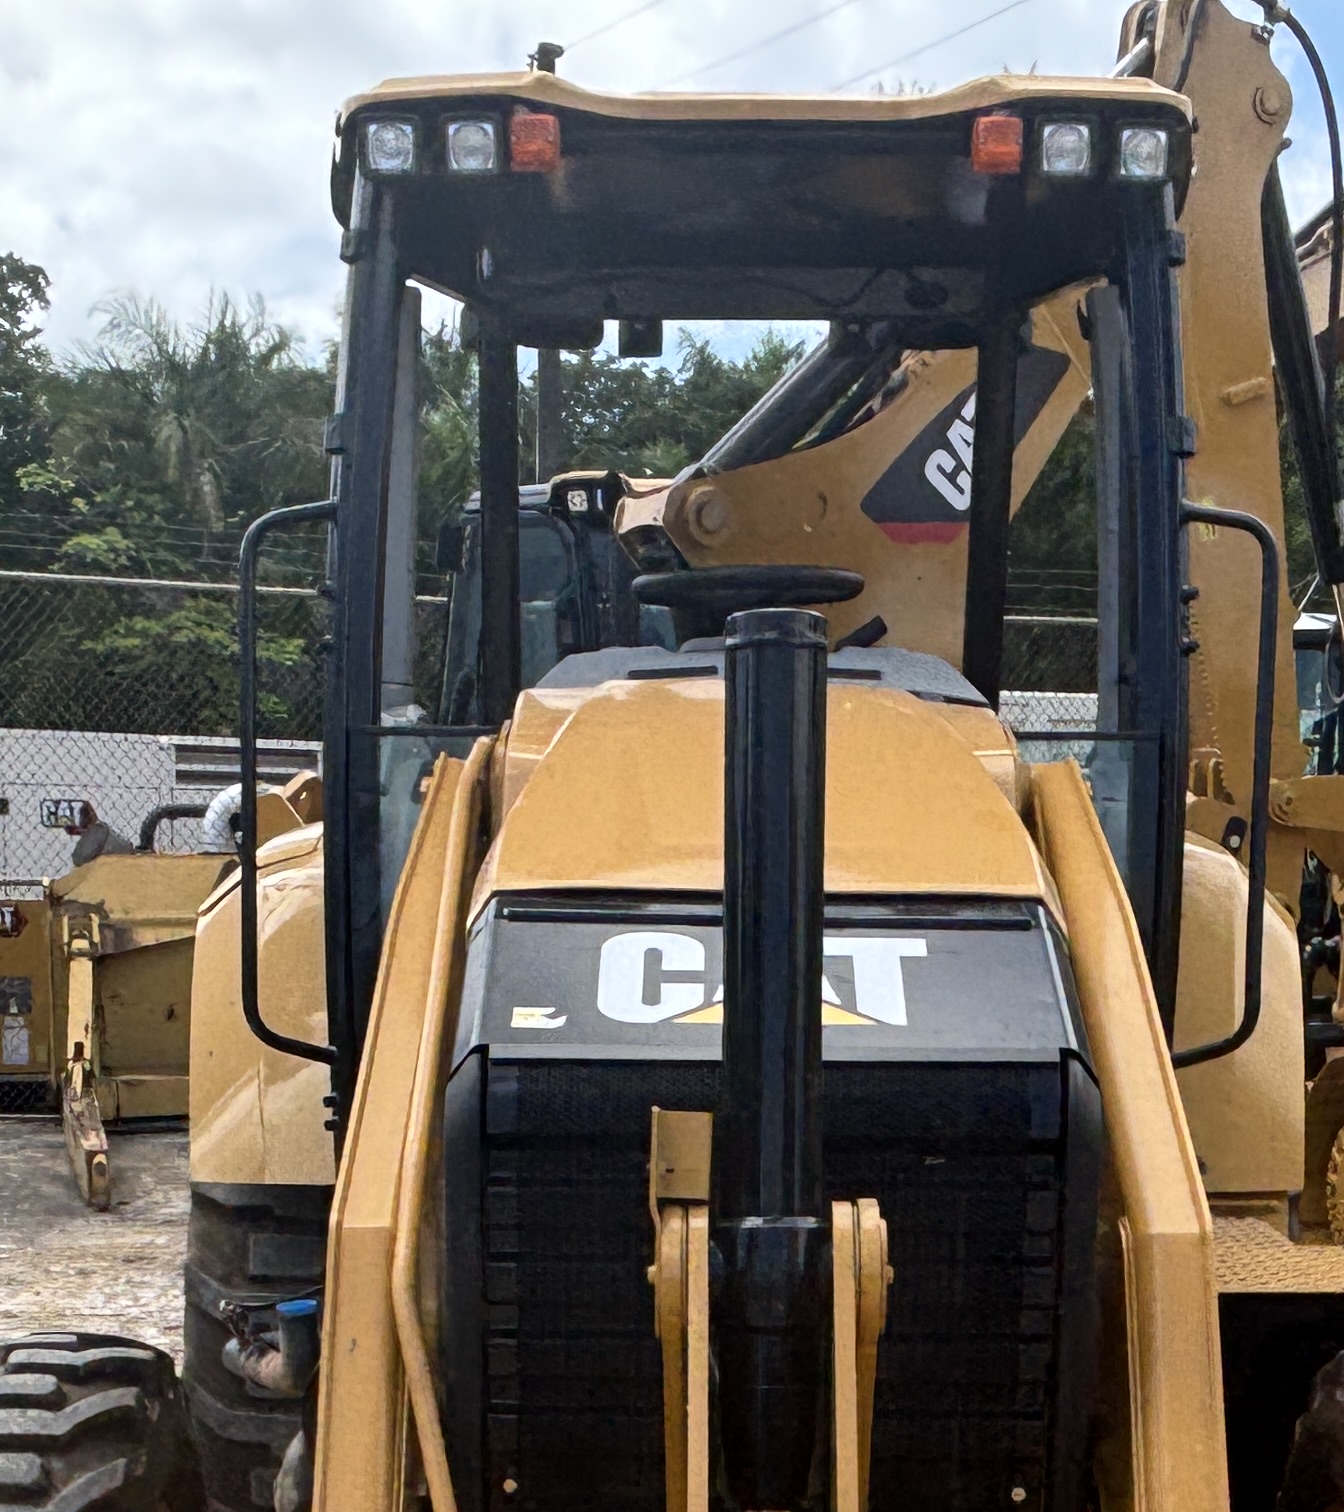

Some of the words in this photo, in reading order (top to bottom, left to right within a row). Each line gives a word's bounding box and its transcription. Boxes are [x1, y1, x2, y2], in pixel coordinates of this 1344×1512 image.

[924, 391, 977, 511] CA
[41, 800, 85, 828] CAT
[596, 931, 929, 1027] CT
